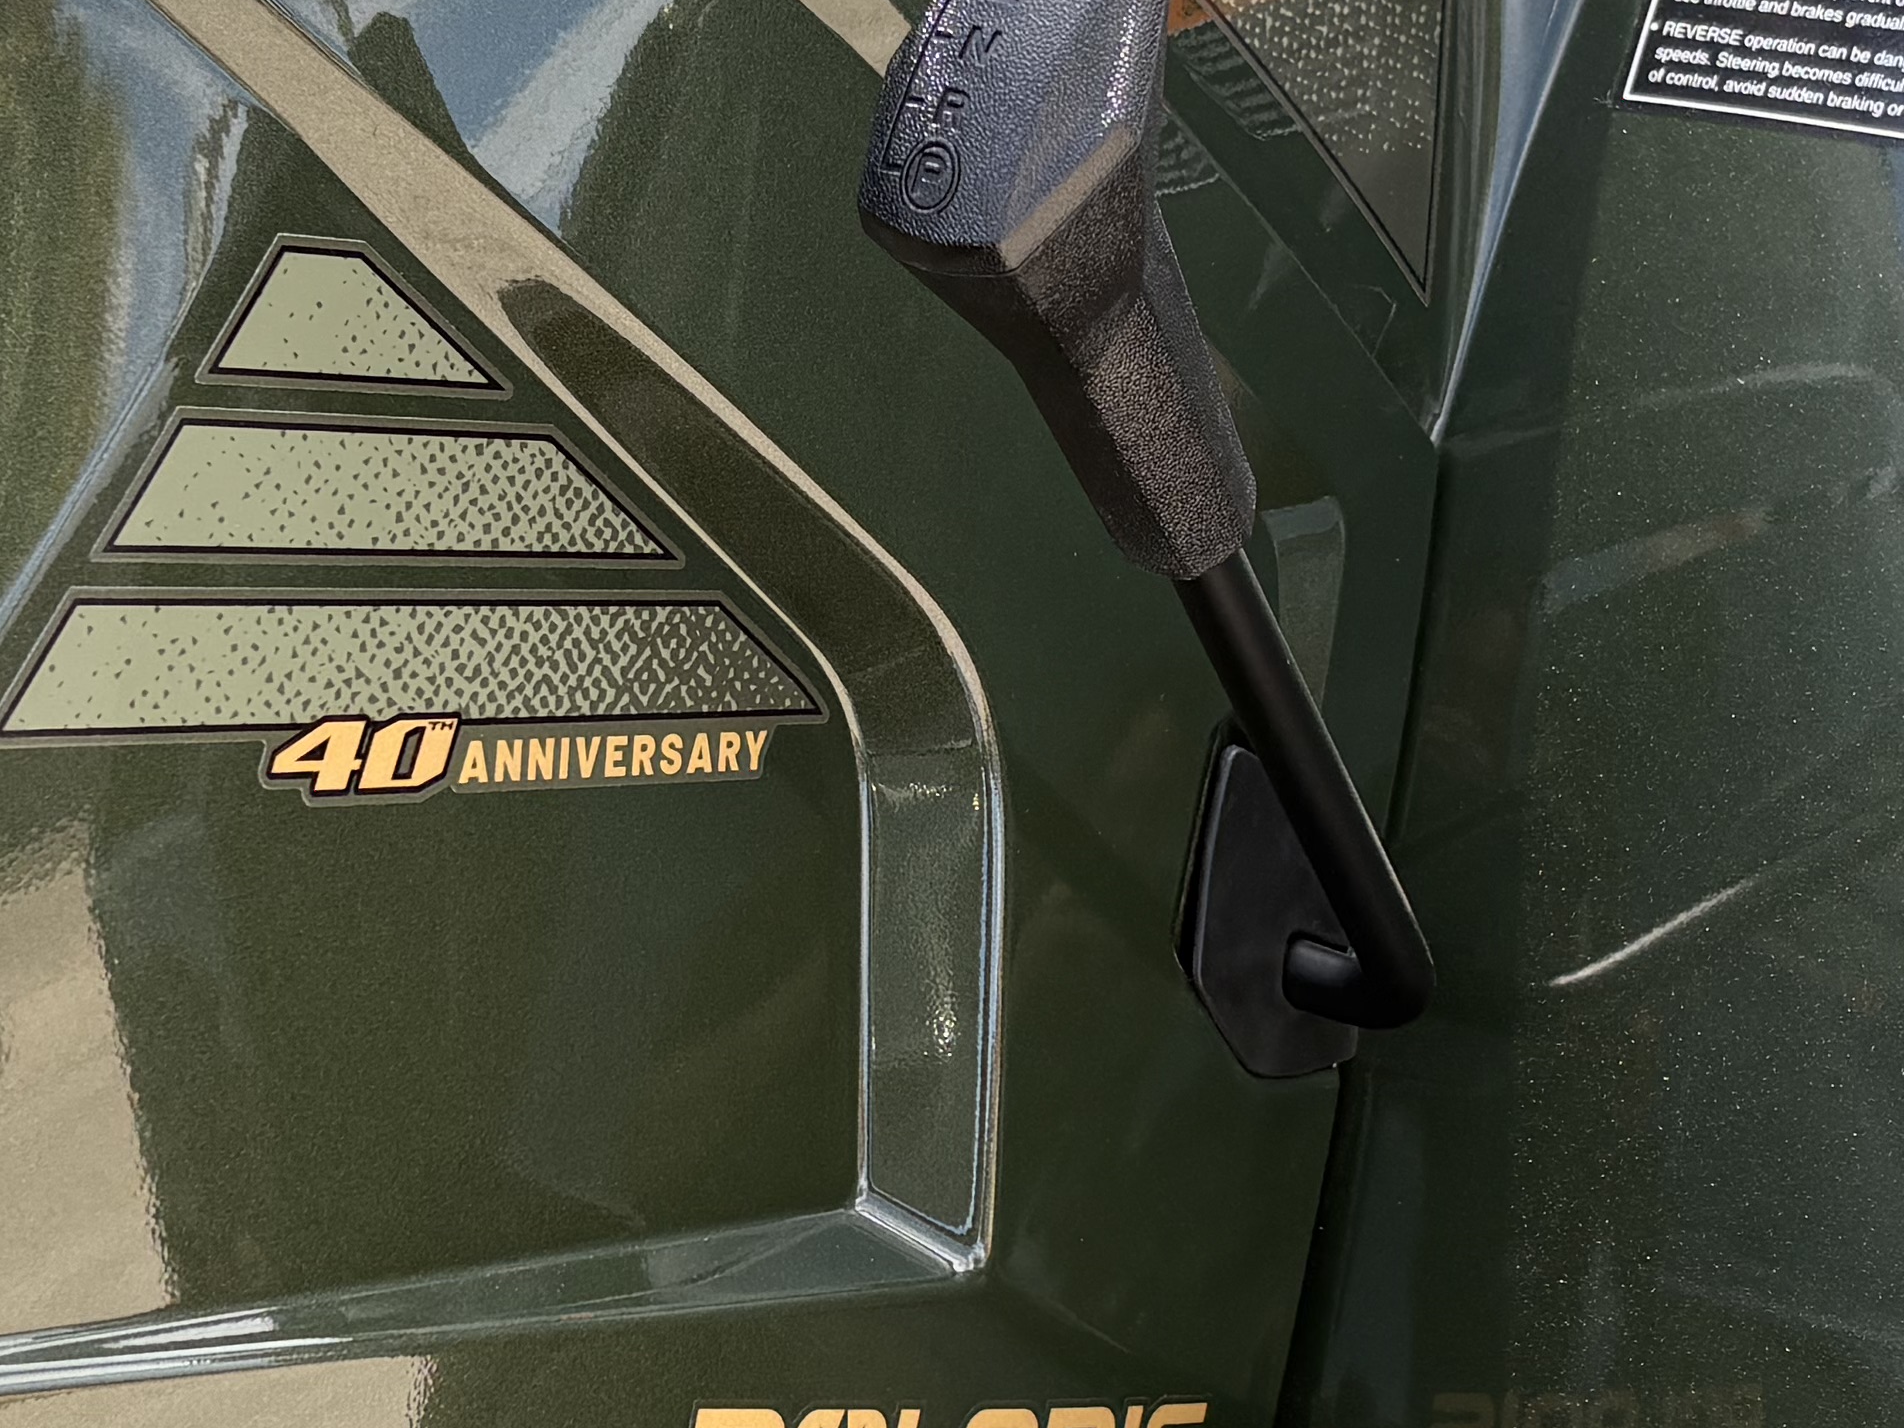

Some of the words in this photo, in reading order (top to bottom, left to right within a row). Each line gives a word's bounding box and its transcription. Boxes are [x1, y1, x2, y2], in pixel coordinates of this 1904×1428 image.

[1757, 0, 1790, 15] and
[1790, 0, 1844, 22] brakes
[959, 24, 1002, 68] N
[1662, 20, 1743, 45] REVERSE
[1743, 34, 1816, 55] operation
[1817, 44, 1848, 60] can
[1849, 45, 1871, 63] be
[1654, 46, 1710, 65] speeds.
[1715, 50, 1780, 78] Steering
[1781, 60, 1852, 85] becomes
[1647, 66, 1665, 82] of
[1665, 71, 1718, 91] control,
[1722, 79, 1766, 96] avoid
[1767, 85, 1824, 104] sudden
[1826, 90, 1885, 117] braking
[457, 729, 768, 785] ANNIVERSARY
